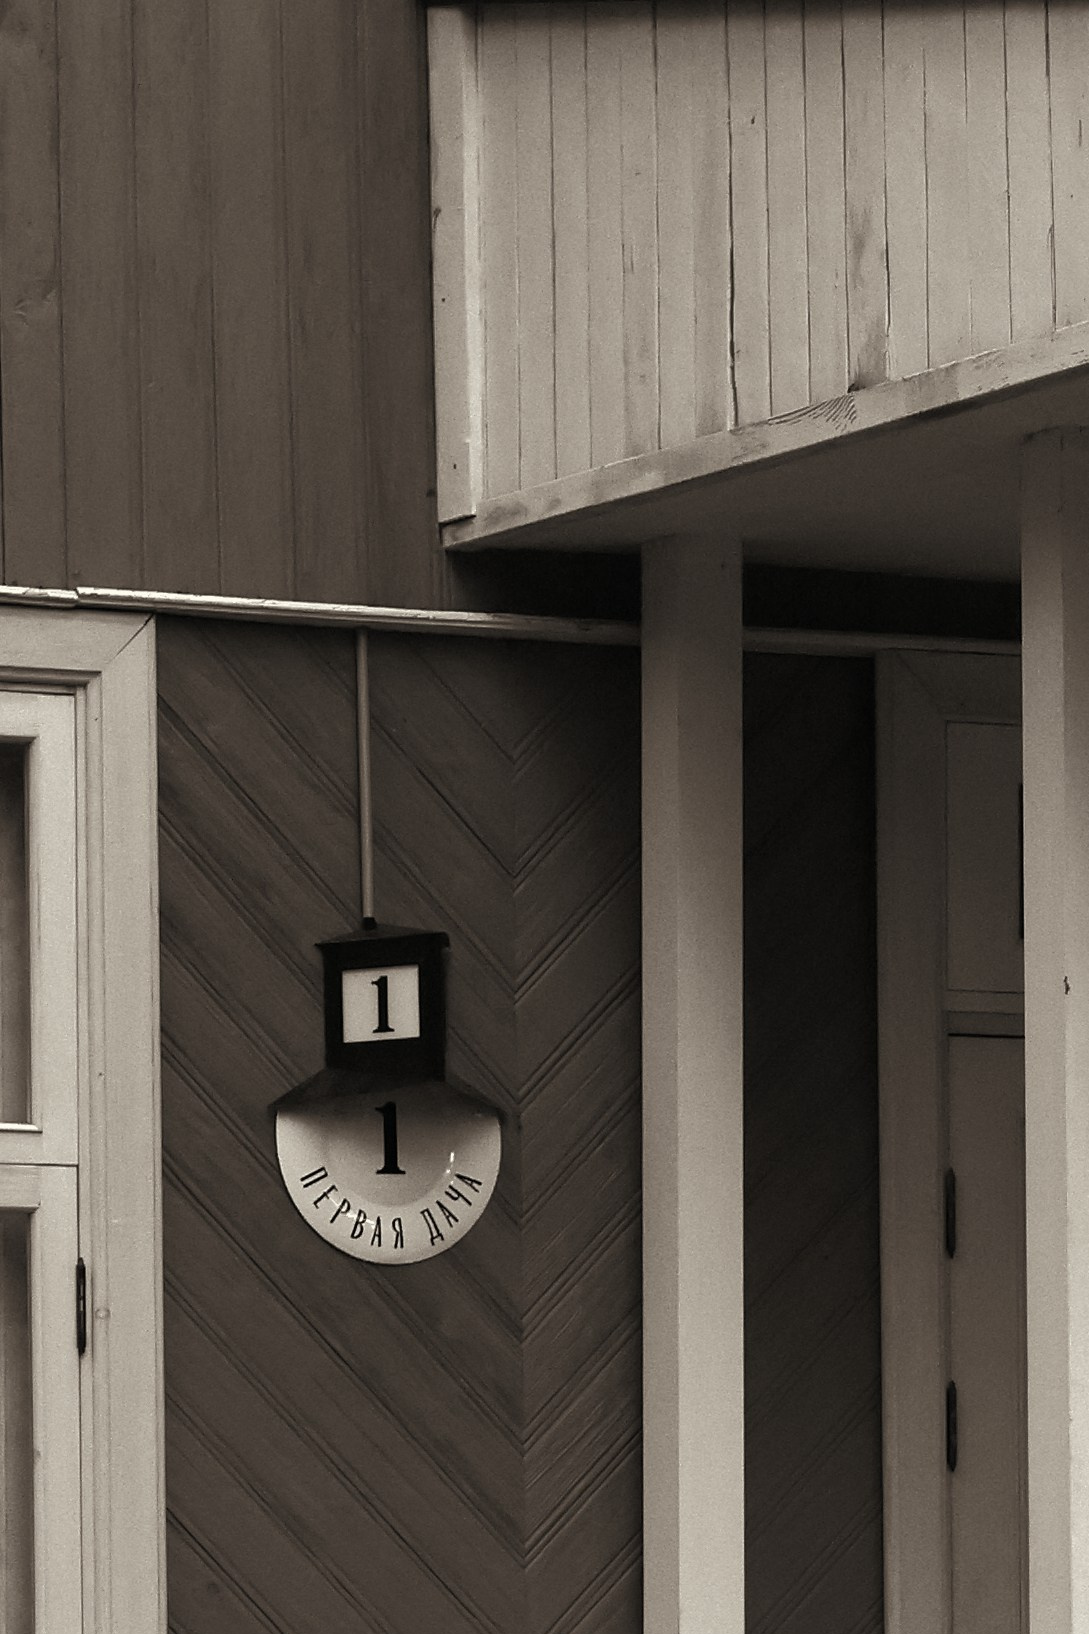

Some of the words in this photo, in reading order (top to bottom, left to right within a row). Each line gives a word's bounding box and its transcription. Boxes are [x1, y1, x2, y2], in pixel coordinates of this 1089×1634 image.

[371, 975, 395, 1034] 1
[375, 1101, 406, 1175] 1
[300, 1167, 404, 1249] ПЕРВАЯ
[420, 1173, 483, 1246] ДАЧА
